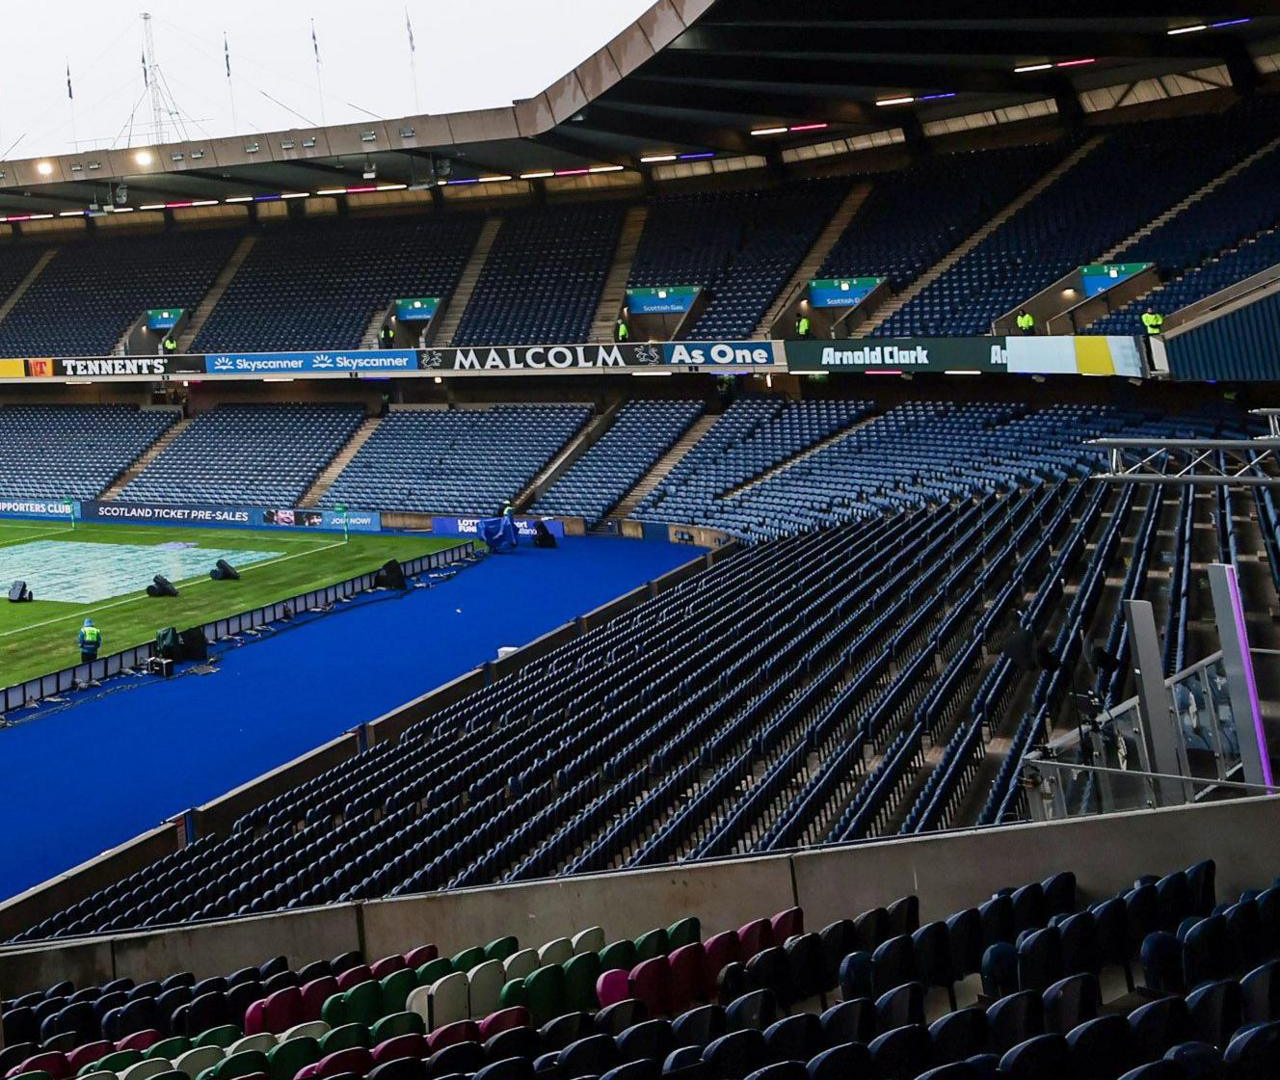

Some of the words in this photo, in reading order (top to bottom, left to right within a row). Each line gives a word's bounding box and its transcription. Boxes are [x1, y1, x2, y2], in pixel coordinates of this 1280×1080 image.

[453, 344, 626, 370] MALCOLM
[671, 345, 704, 364] As
[710, 344, 768, 364] One
[821, 346, 881, 364] Arnold
[883, 346, 928, 364] Clark
[62, 359, 165, 376] TENNENT'S
[236, 358, 303, 370] Skyscanner
[336, 356, 408, 369] Skyscanner
[48, 502, 72, 514] CLUB
[99, 507, 152, 517] SCOTLAND
[154, 508, 189, 519] TICKET
[191, 510, 248, 522] PRE-SALES
